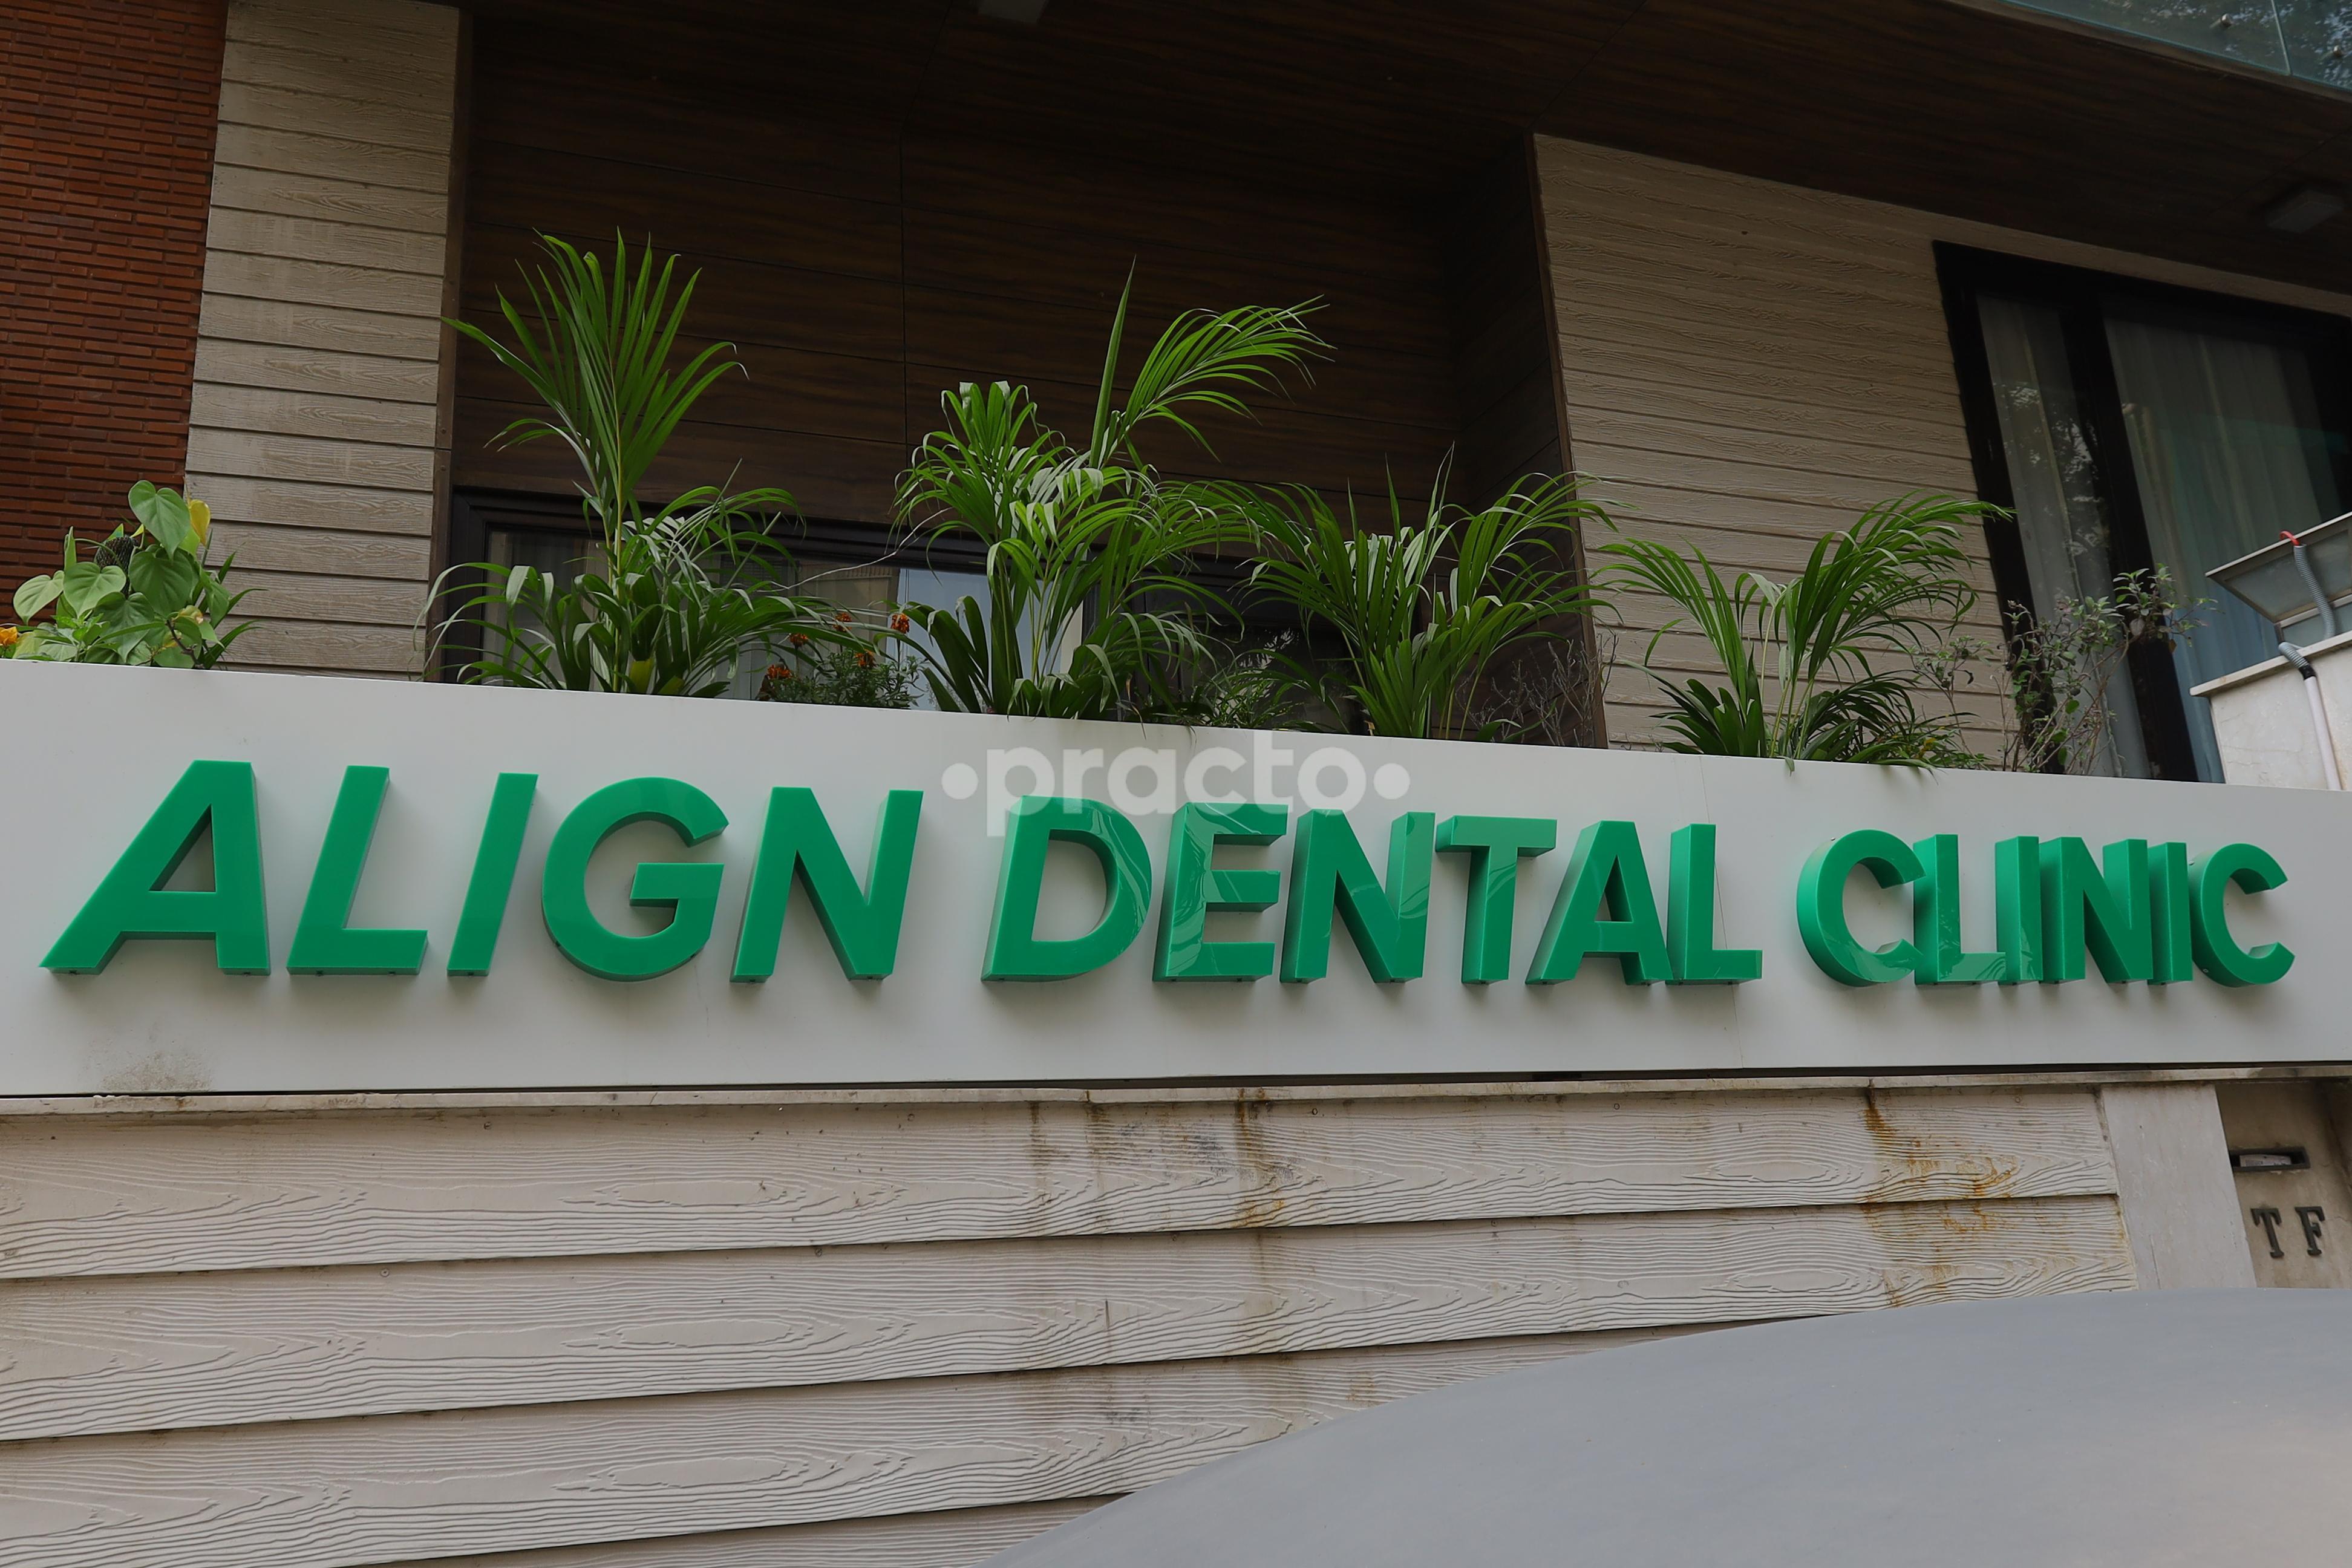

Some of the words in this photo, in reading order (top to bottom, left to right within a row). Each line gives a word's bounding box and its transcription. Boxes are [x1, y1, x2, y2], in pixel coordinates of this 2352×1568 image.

[39, 759, 924, 983] ALIGN
[981, 795, 1763, 985] DENTAL
[1795, 828, 2296, 987] CLINIC
